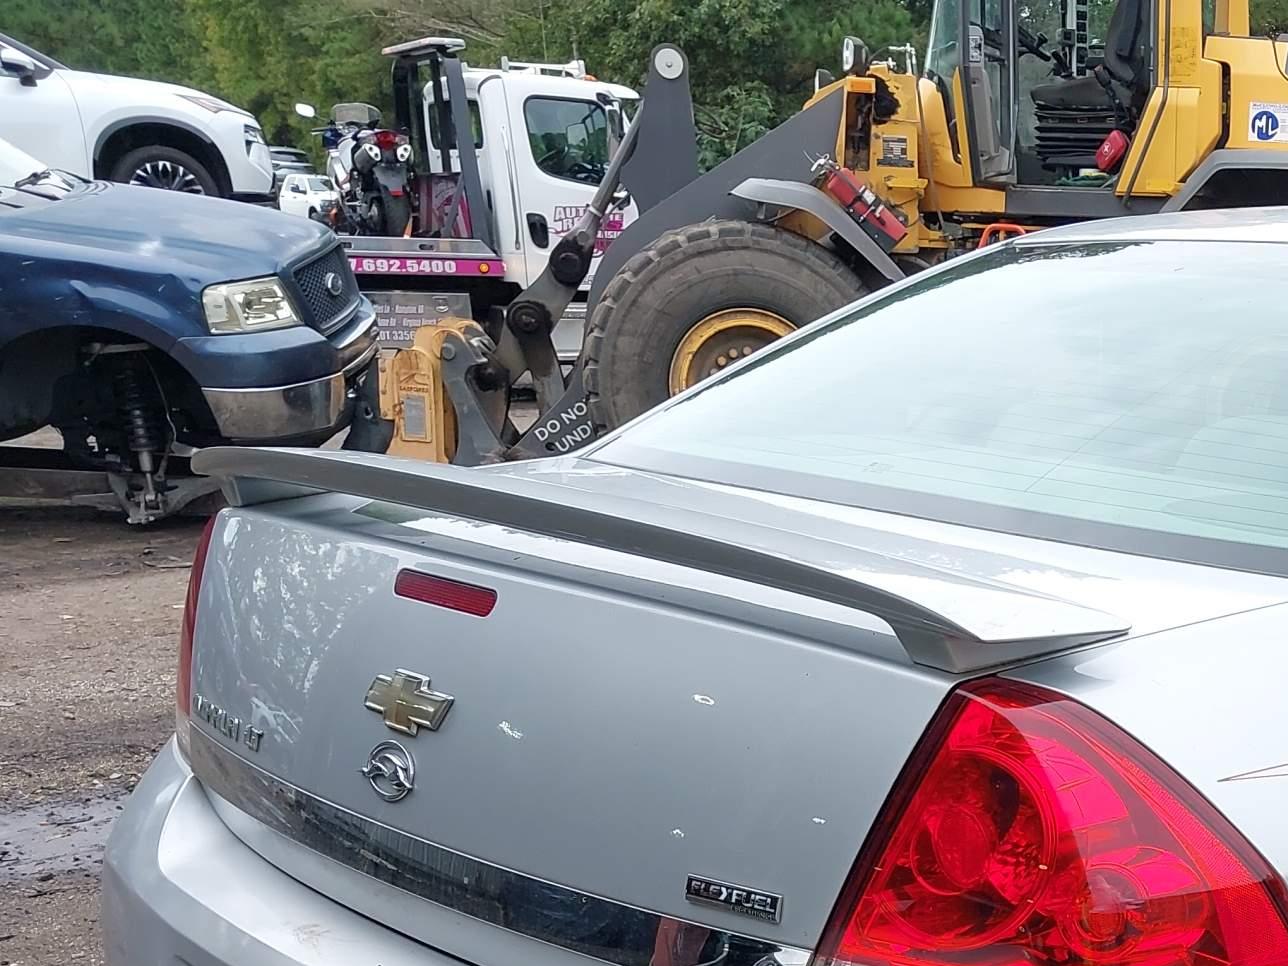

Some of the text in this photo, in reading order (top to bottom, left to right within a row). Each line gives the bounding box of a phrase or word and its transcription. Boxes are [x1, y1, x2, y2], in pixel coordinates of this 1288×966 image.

[554, 205, 588, 221] AUT
[348, 257, 457, 273] 7.692.5400
[393, 330, 416, 341] 3356
[534, 398, 588, 441] DO NO
[554, 420, 593, 452] UND
